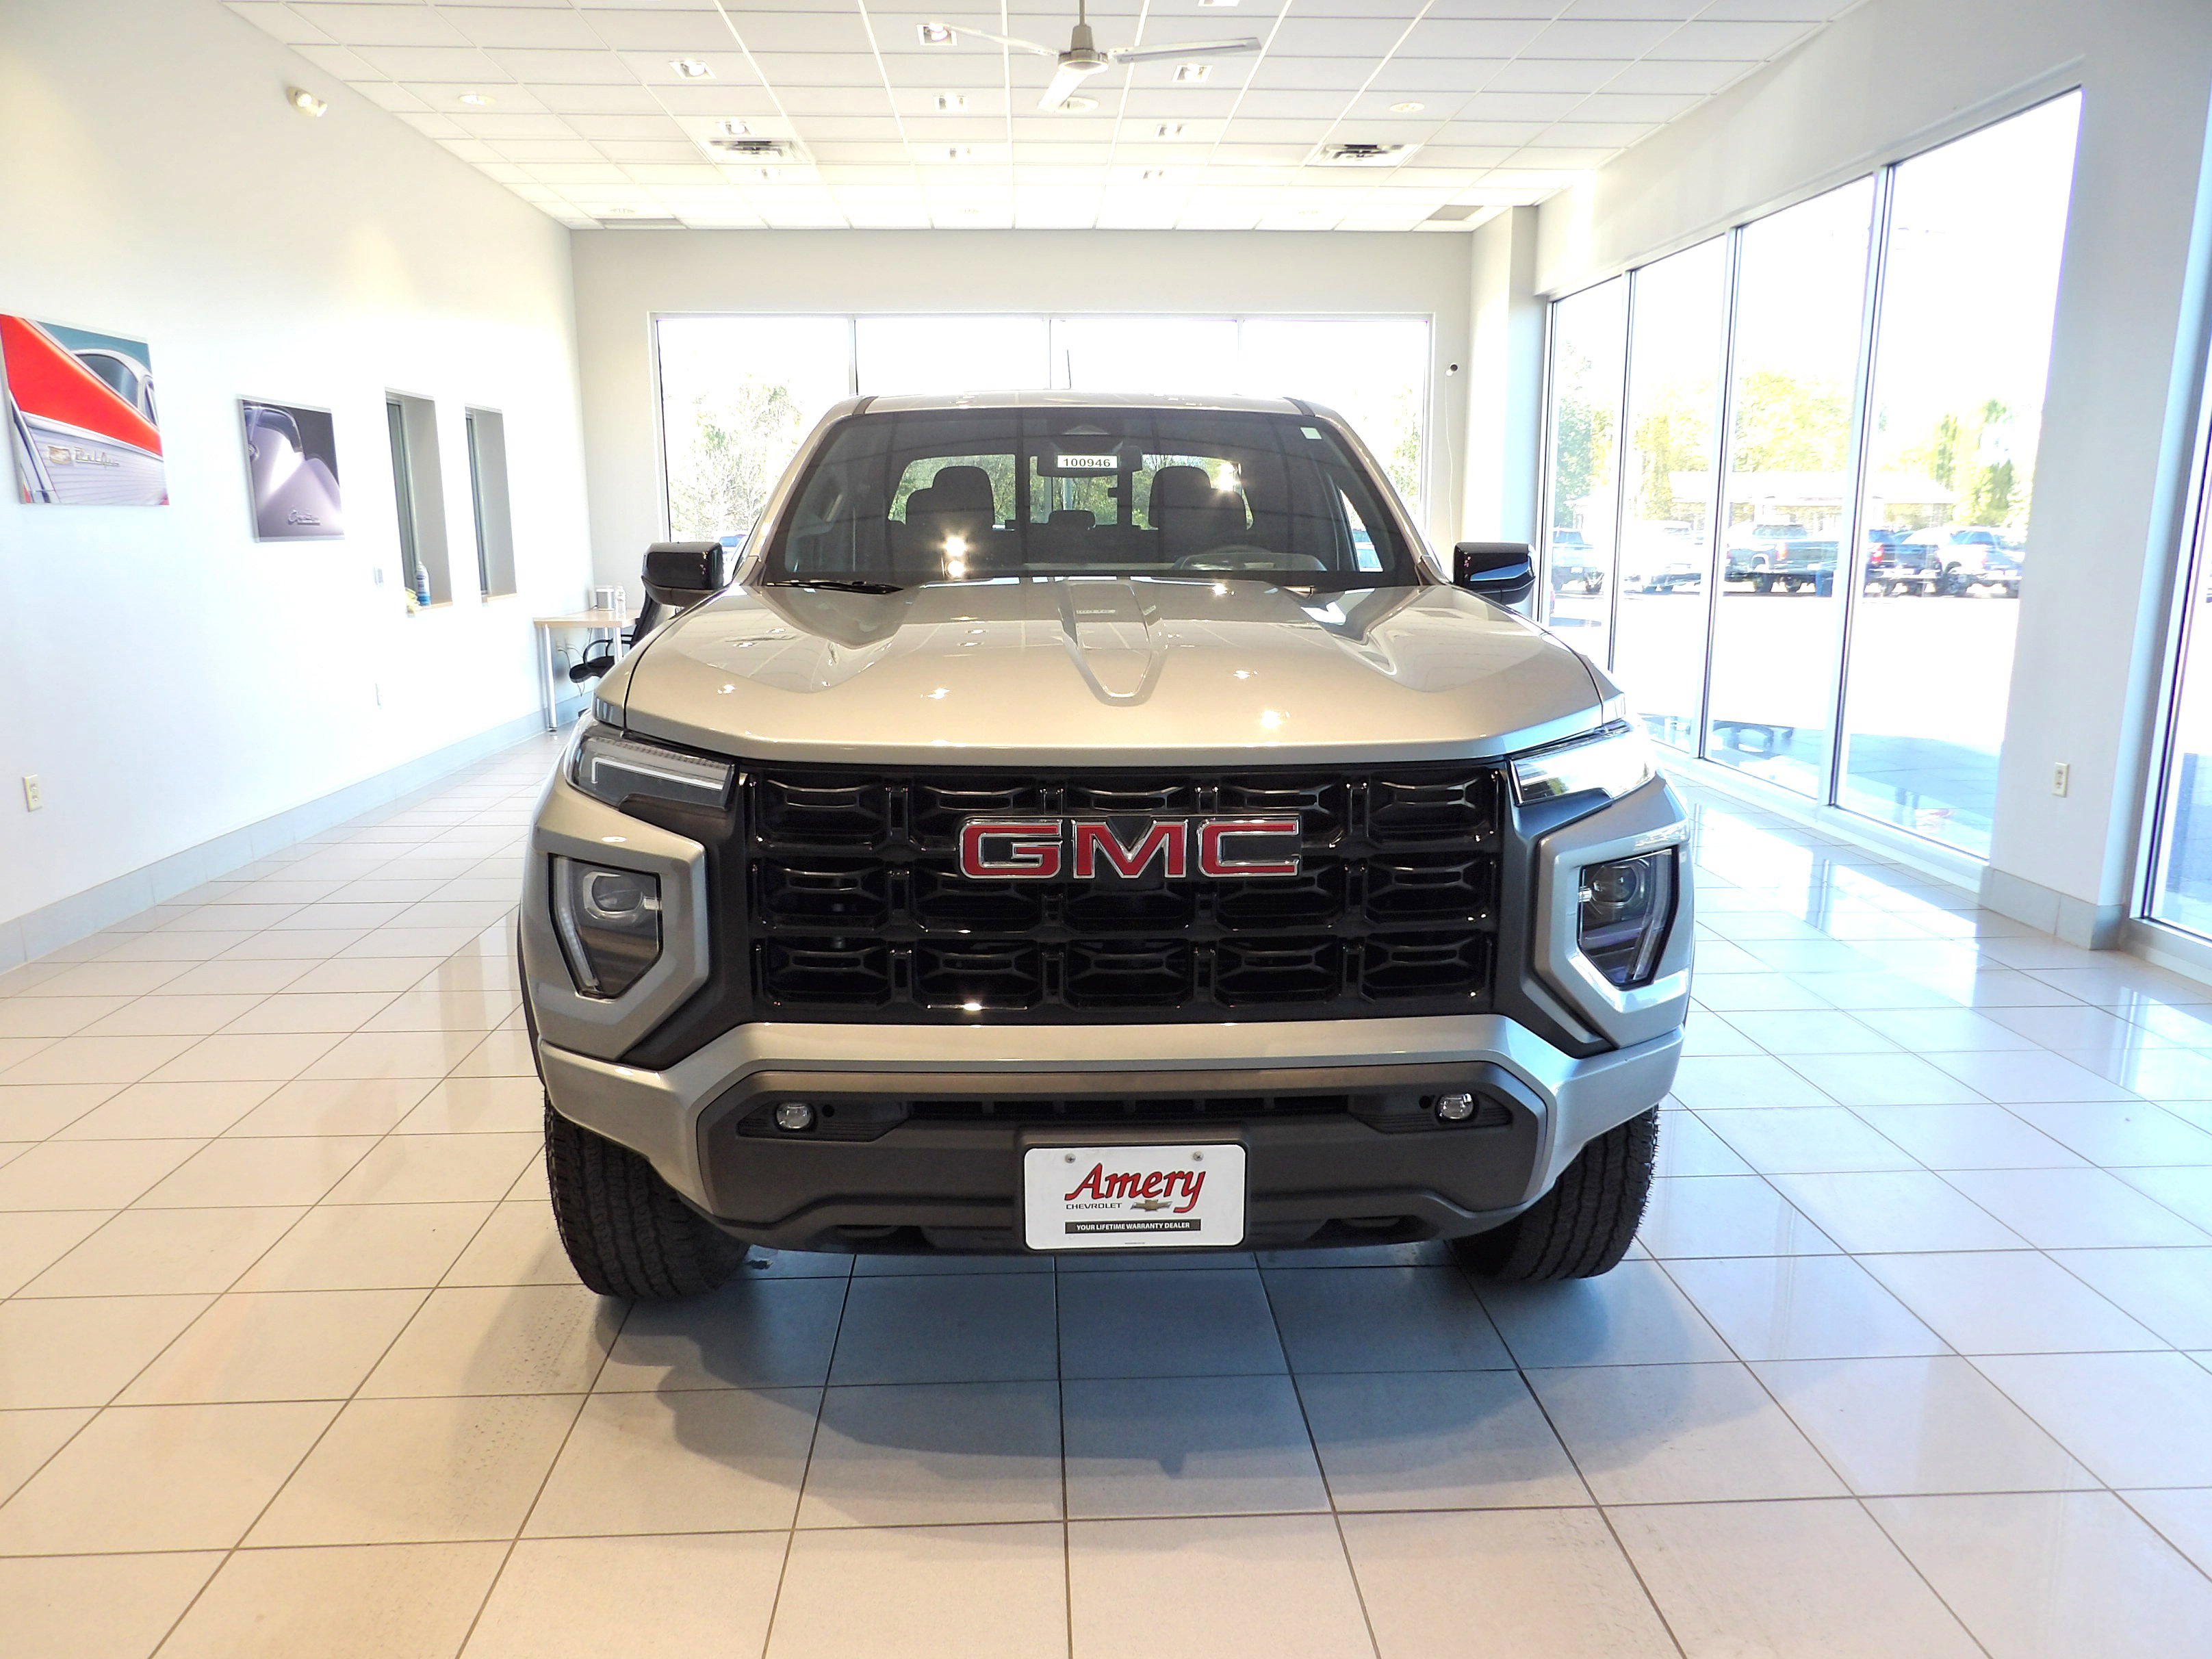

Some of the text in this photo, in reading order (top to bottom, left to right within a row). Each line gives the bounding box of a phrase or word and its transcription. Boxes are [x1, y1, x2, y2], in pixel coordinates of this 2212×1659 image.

[1064, 459, 1110, 467] 100946
[960, 819, 1299, 879] GMC
[1064, 1162, 1206, 1213] Amery
